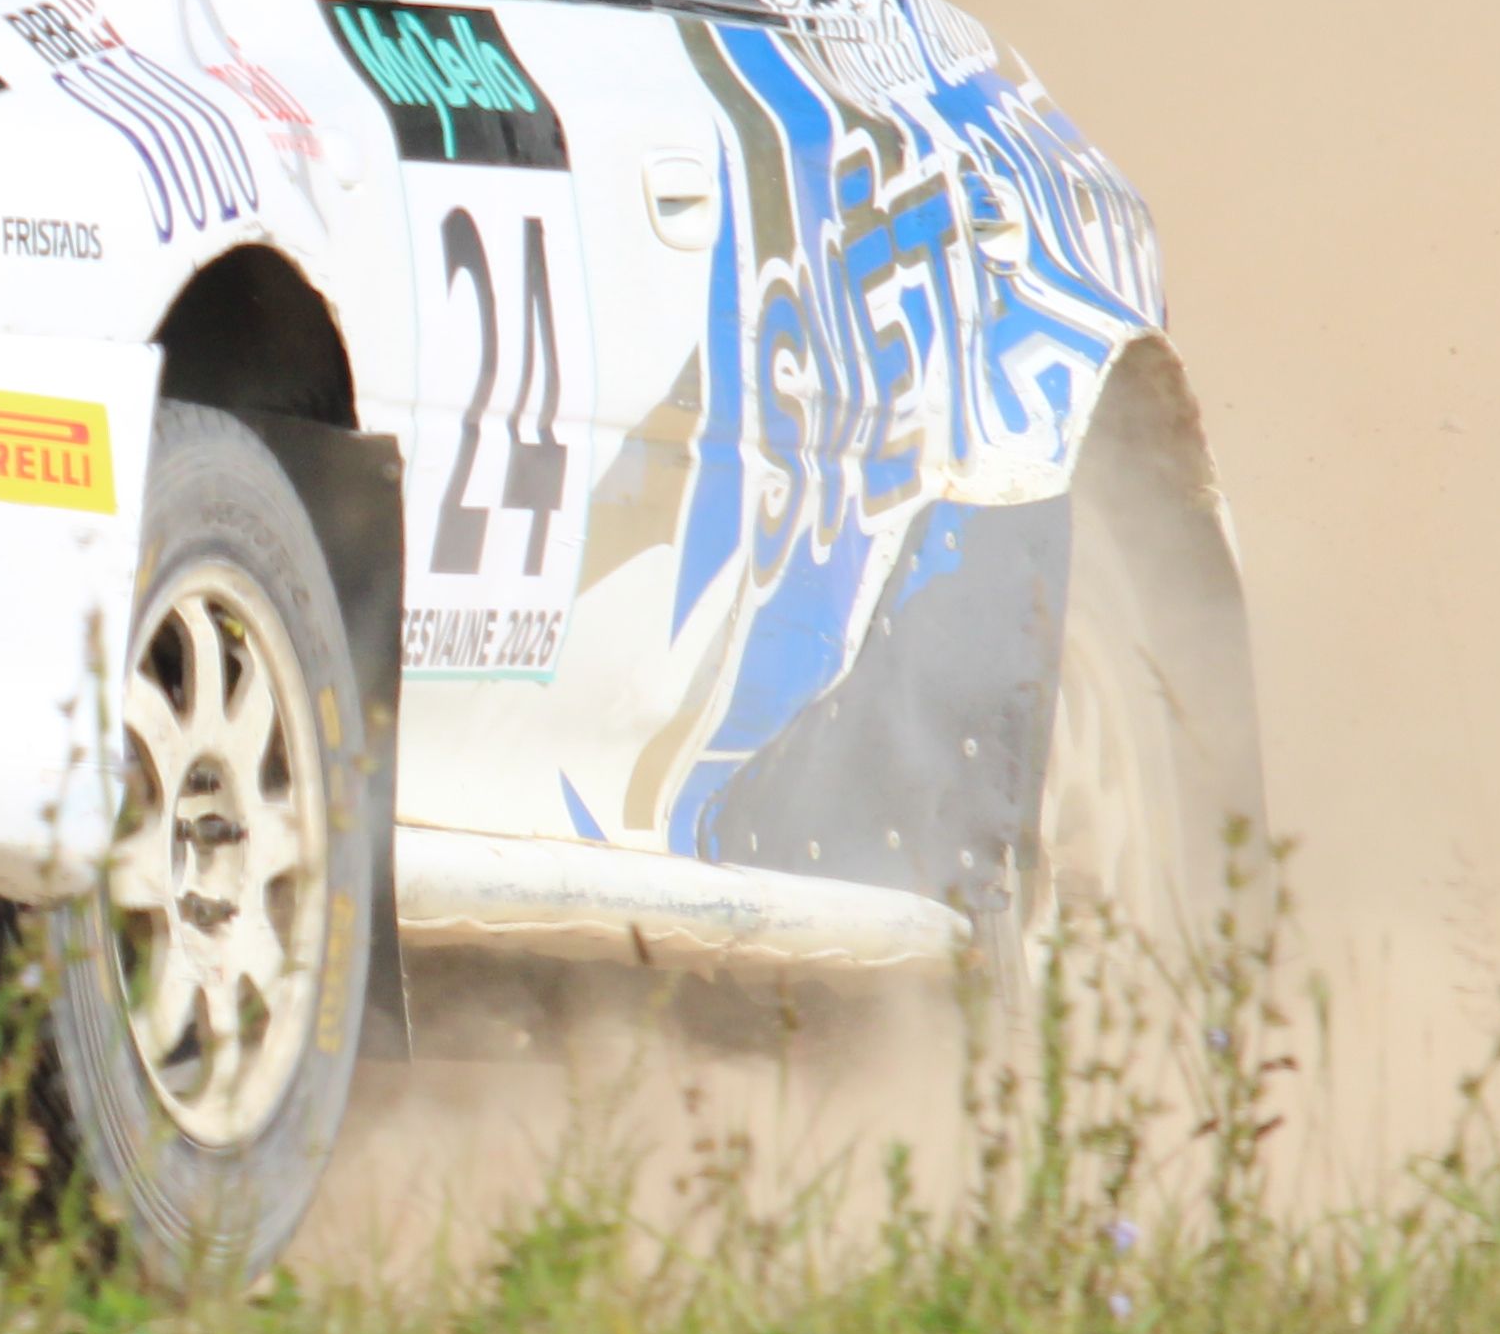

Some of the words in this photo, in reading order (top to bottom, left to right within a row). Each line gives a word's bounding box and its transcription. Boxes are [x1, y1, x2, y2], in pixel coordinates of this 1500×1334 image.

[1, 216, 102, 261] FRISTADS
[429, 205, 567, 577] 24
[495, 609, 563, 667] 2026
